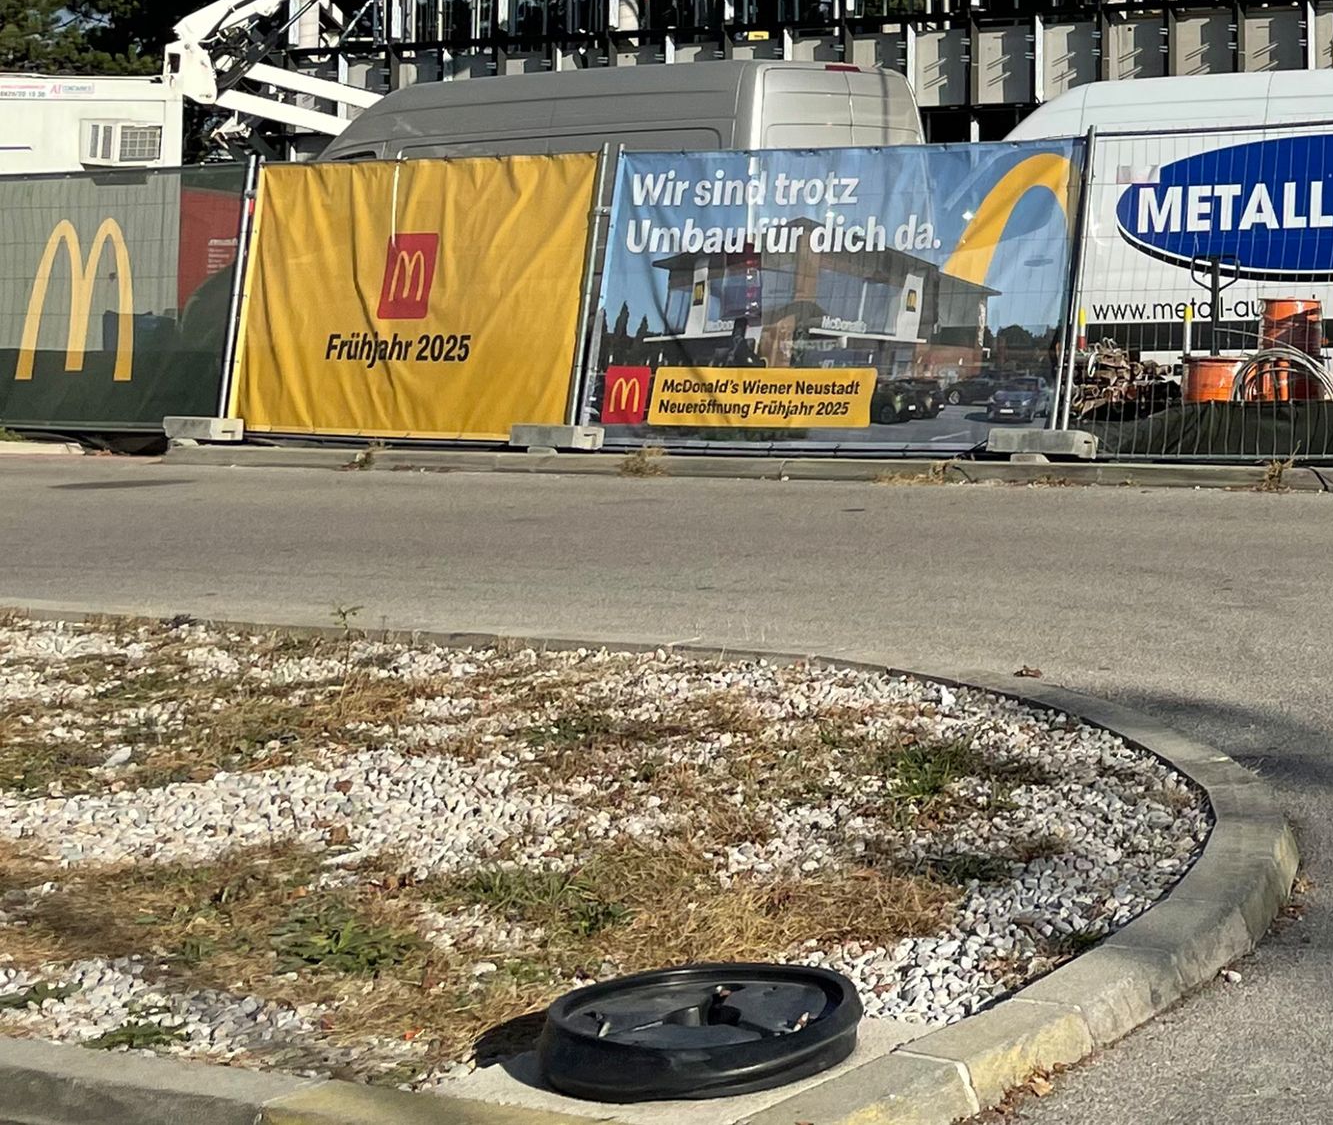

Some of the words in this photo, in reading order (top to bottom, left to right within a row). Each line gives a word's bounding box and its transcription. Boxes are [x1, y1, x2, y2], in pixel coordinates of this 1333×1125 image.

[632, 170, 690, 206] Wir
[694, 169, 768, 206] sind
[774, 171, 860, 206] trotz
[625, 218, 745, 254] Umbau
[752, 216, 812, 254] für
[810, 213, 886, 254] dich
[893, 215, 942, 251] da.
[325, 332, 413, 369] Frühjahr
[415, 334, 472, 362] 2025
[661, 378, 739, 395] McDonald's
[742, 380, 793, 395] Wiener
[795, 380, 861, 395] Neustadt
[658, 399, 751, 418] Neueröffnung
[753, 400, 814, 420] Frühjahr
[815, 401, 850, 416] 2025
